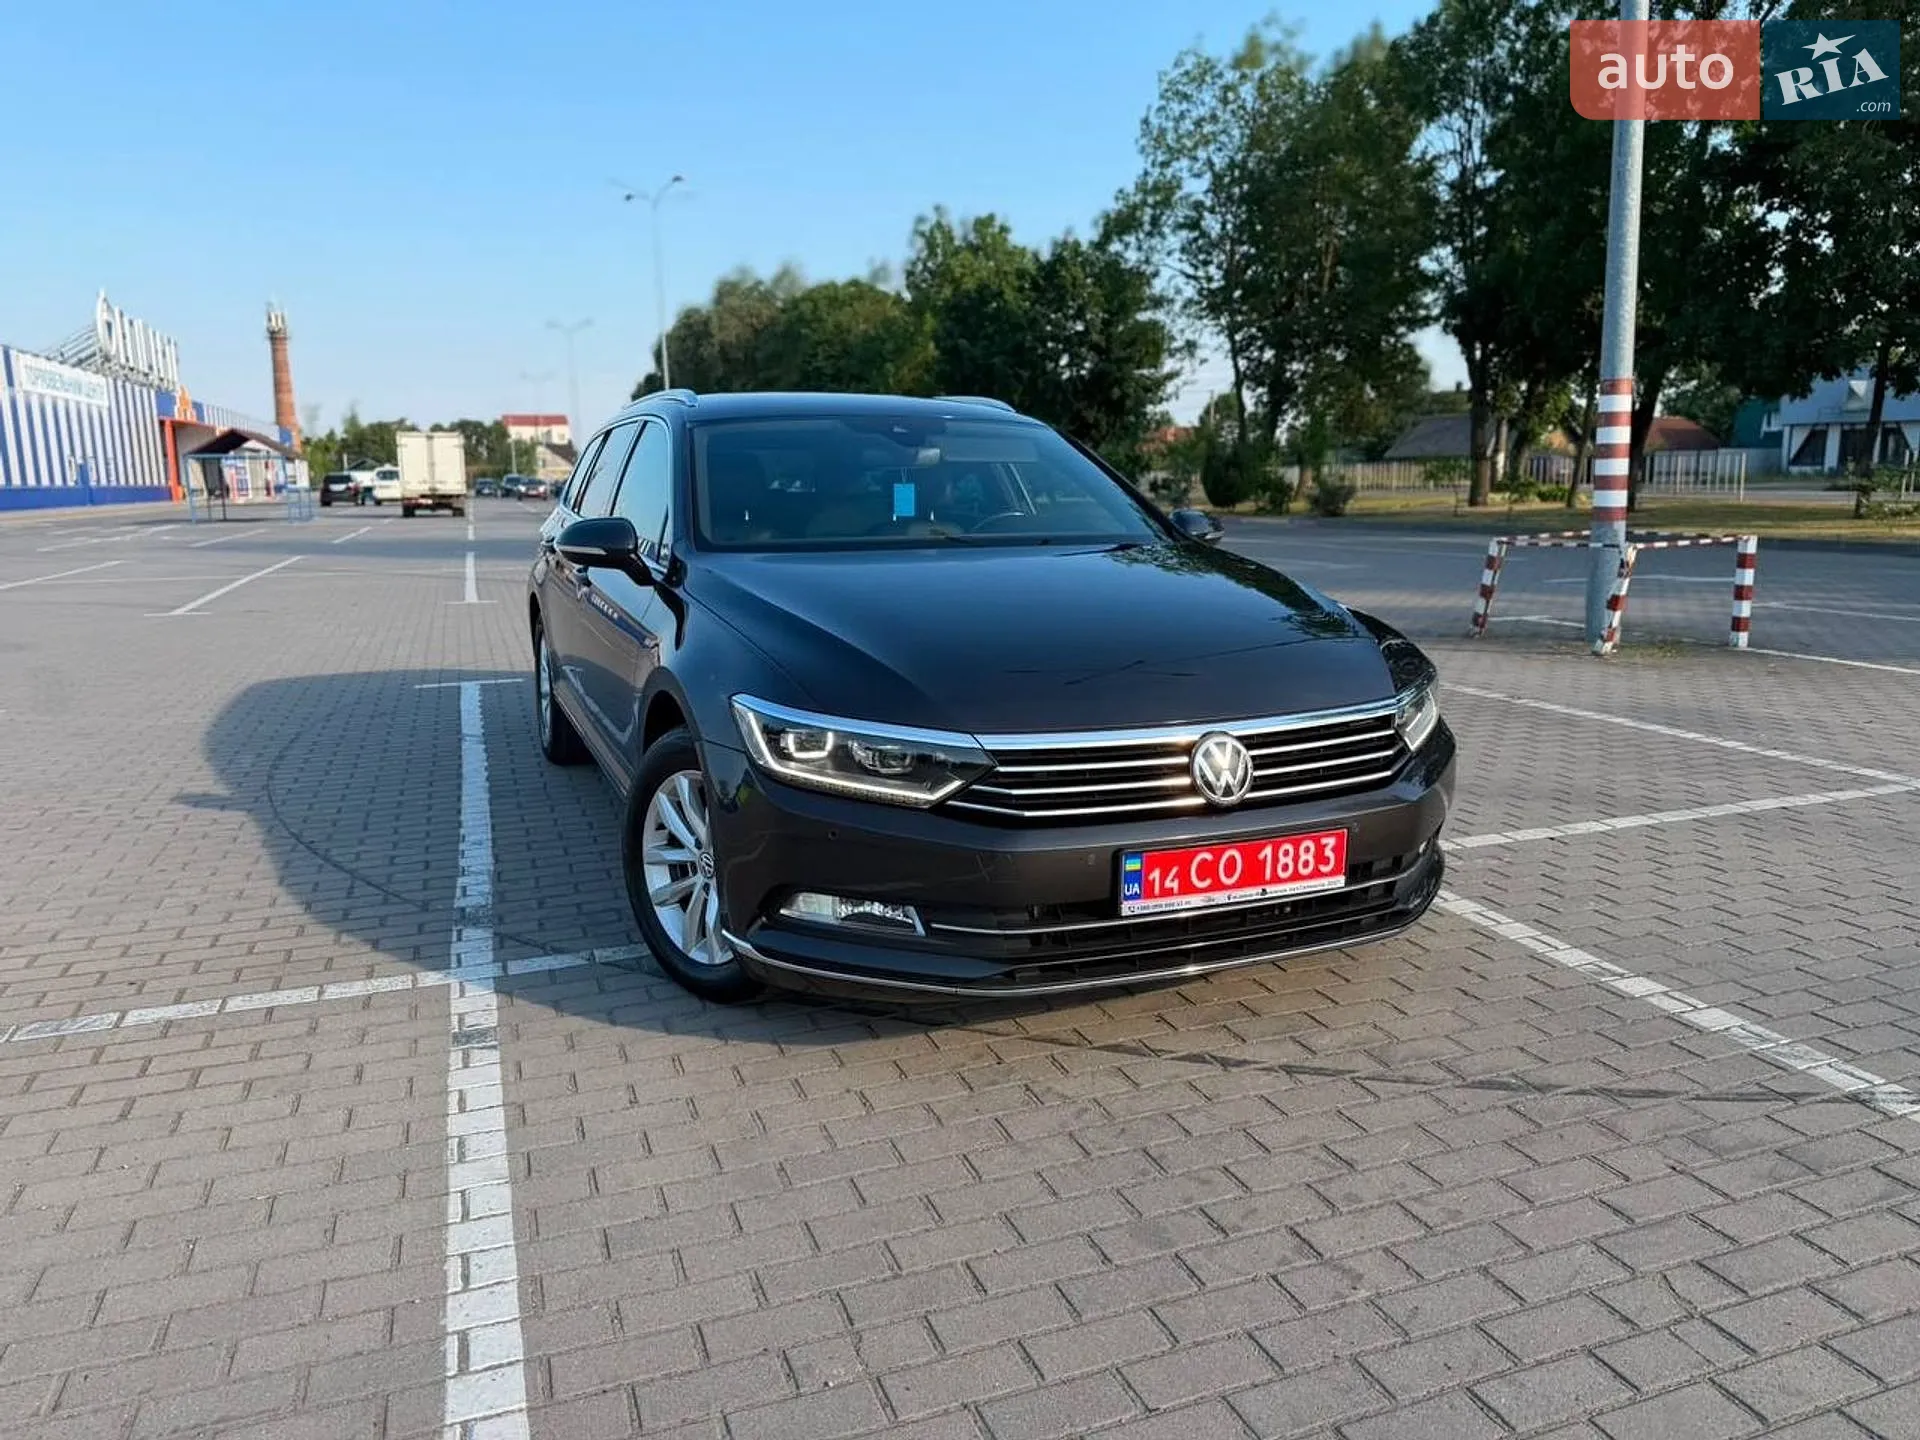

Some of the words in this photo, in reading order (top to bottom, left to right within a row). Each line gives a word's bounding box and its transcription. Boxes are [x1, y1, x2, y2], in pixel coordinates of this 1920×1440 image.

[1148, 866, 1180, 897] 14
[1190, 848, 1243, 889] CO
[1257, 836, 1337, 882] 1883
[1124, 883, 1140, 896] UA
